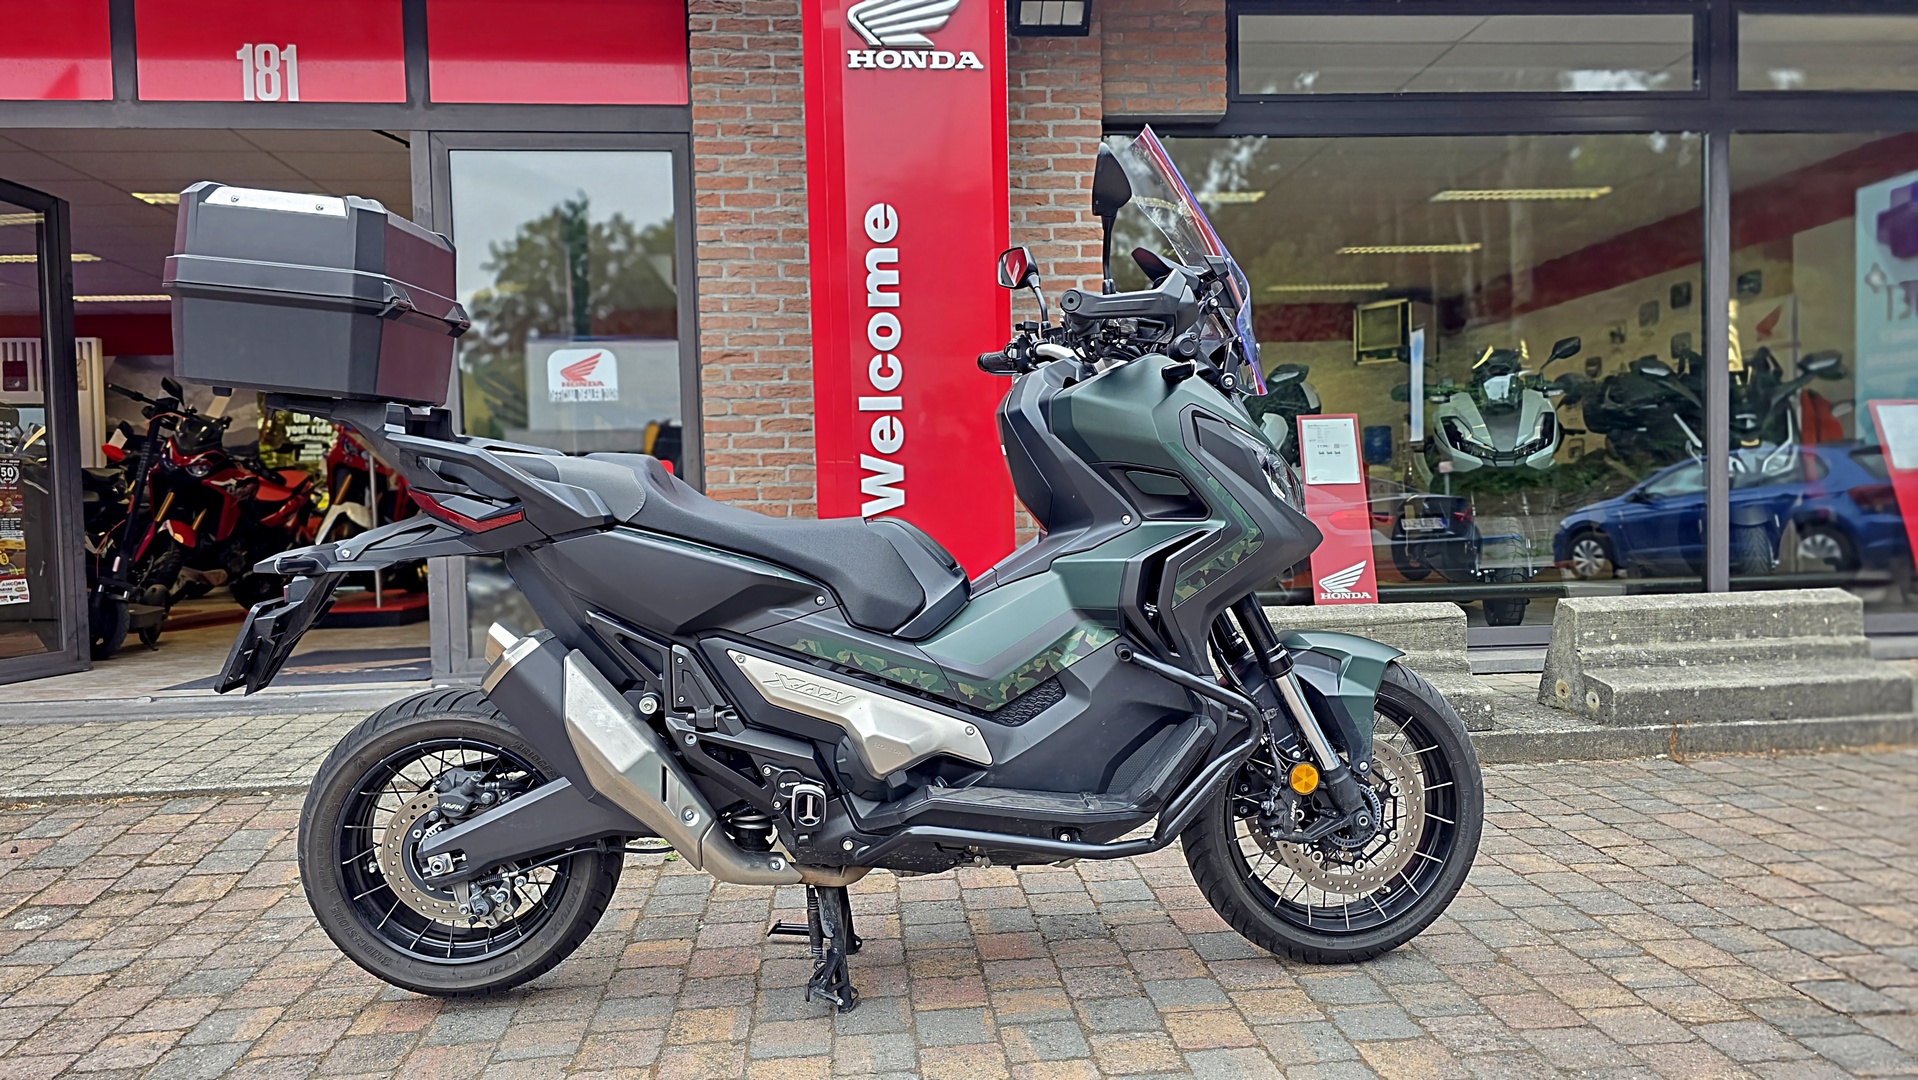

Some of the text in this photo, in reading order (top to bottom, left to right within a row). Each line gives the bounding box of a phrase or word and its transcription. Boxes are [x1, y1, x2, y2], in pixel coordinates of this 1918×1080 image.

[847, 49, 984, 70] HONDA
[236, 43, 300, 102] 181
[858, 203, 905, 518] Welcome
[285, 421, 332, 437] your ride
[0, 466, 14, 478] 50
[1320, 592, 1372, 600] HONDA
